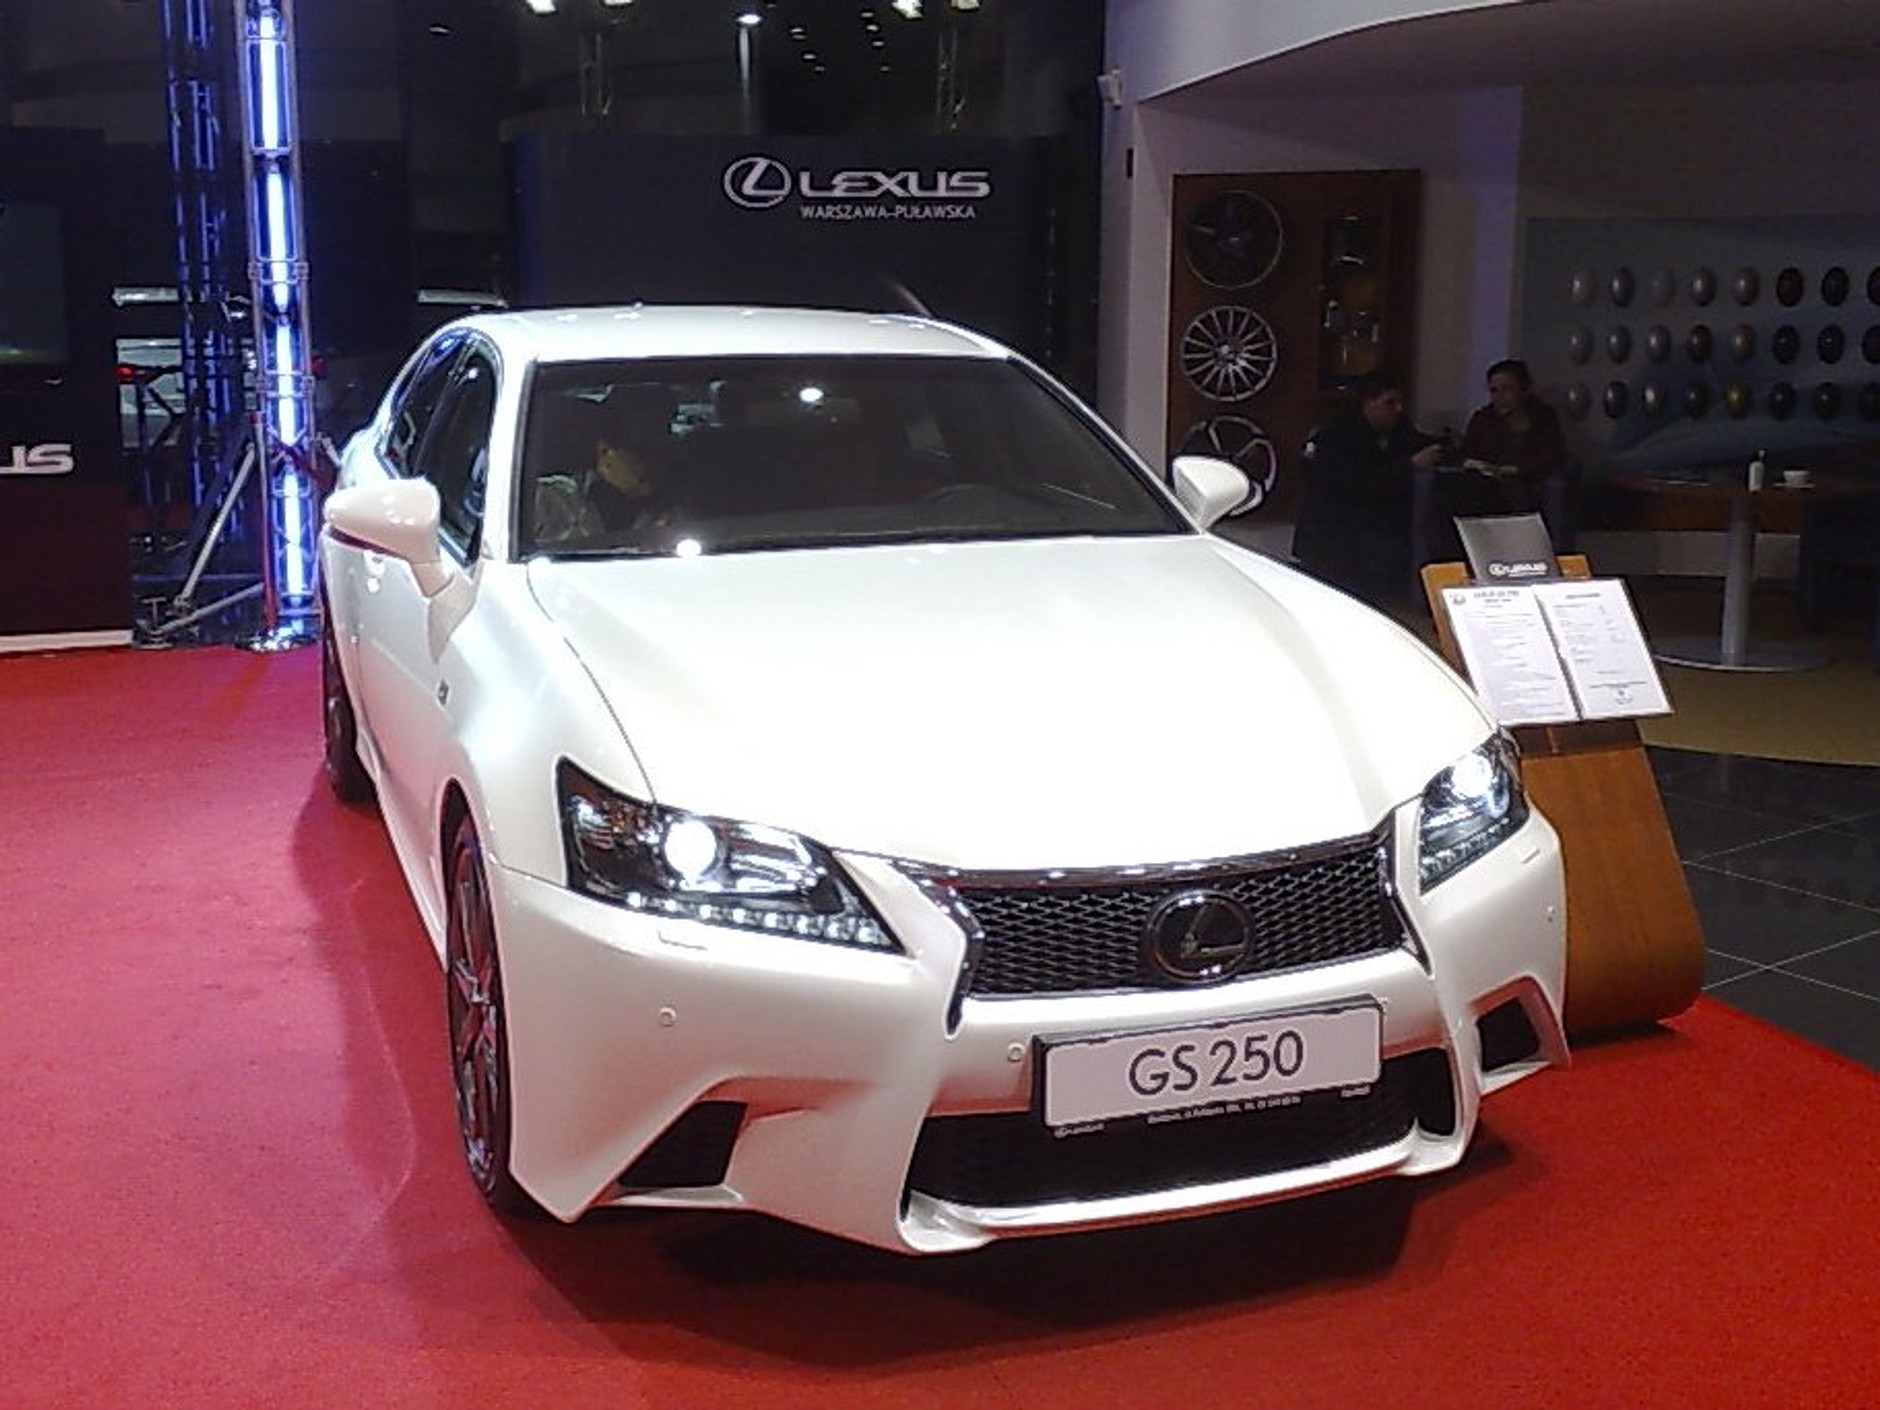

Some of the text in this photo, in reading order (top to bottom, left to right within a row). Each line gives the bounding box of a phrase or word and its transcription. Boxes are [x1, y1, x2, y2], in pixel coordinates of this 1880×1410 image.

[800, 170, 991, 198] LEXUS
[1128, 1030, 1304, 1096] GS 250
